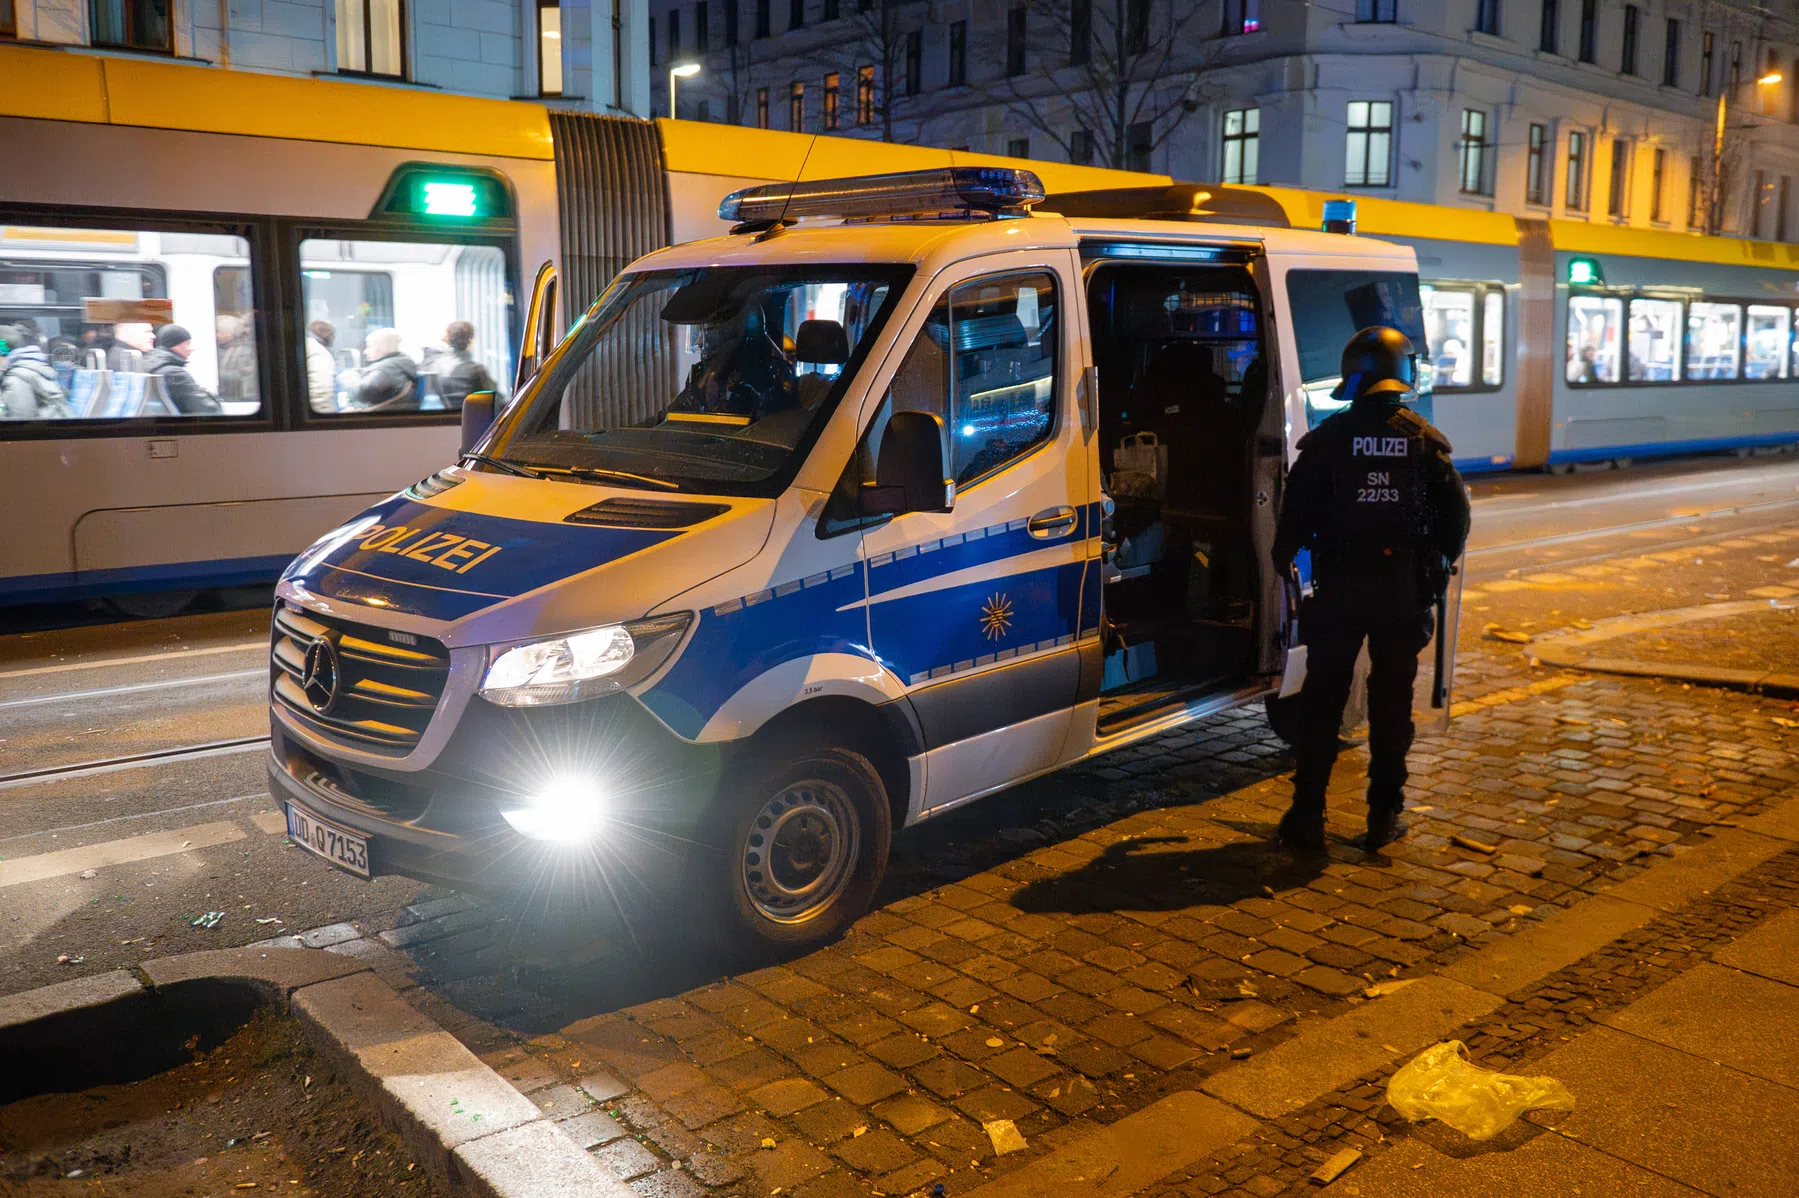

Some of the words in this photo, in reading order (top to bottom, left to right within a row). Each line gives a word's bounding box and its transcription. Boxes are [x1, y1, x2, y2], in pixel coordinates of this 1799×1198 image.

[1352, 436, 1408, 457] POLIZEI
[1367, 471, 1390, 486] SN
[1357, 488, 1400, 502] 22/33
[352, 524, 503, 575] POLIZEI
[293, 811, 310, 843] DD
